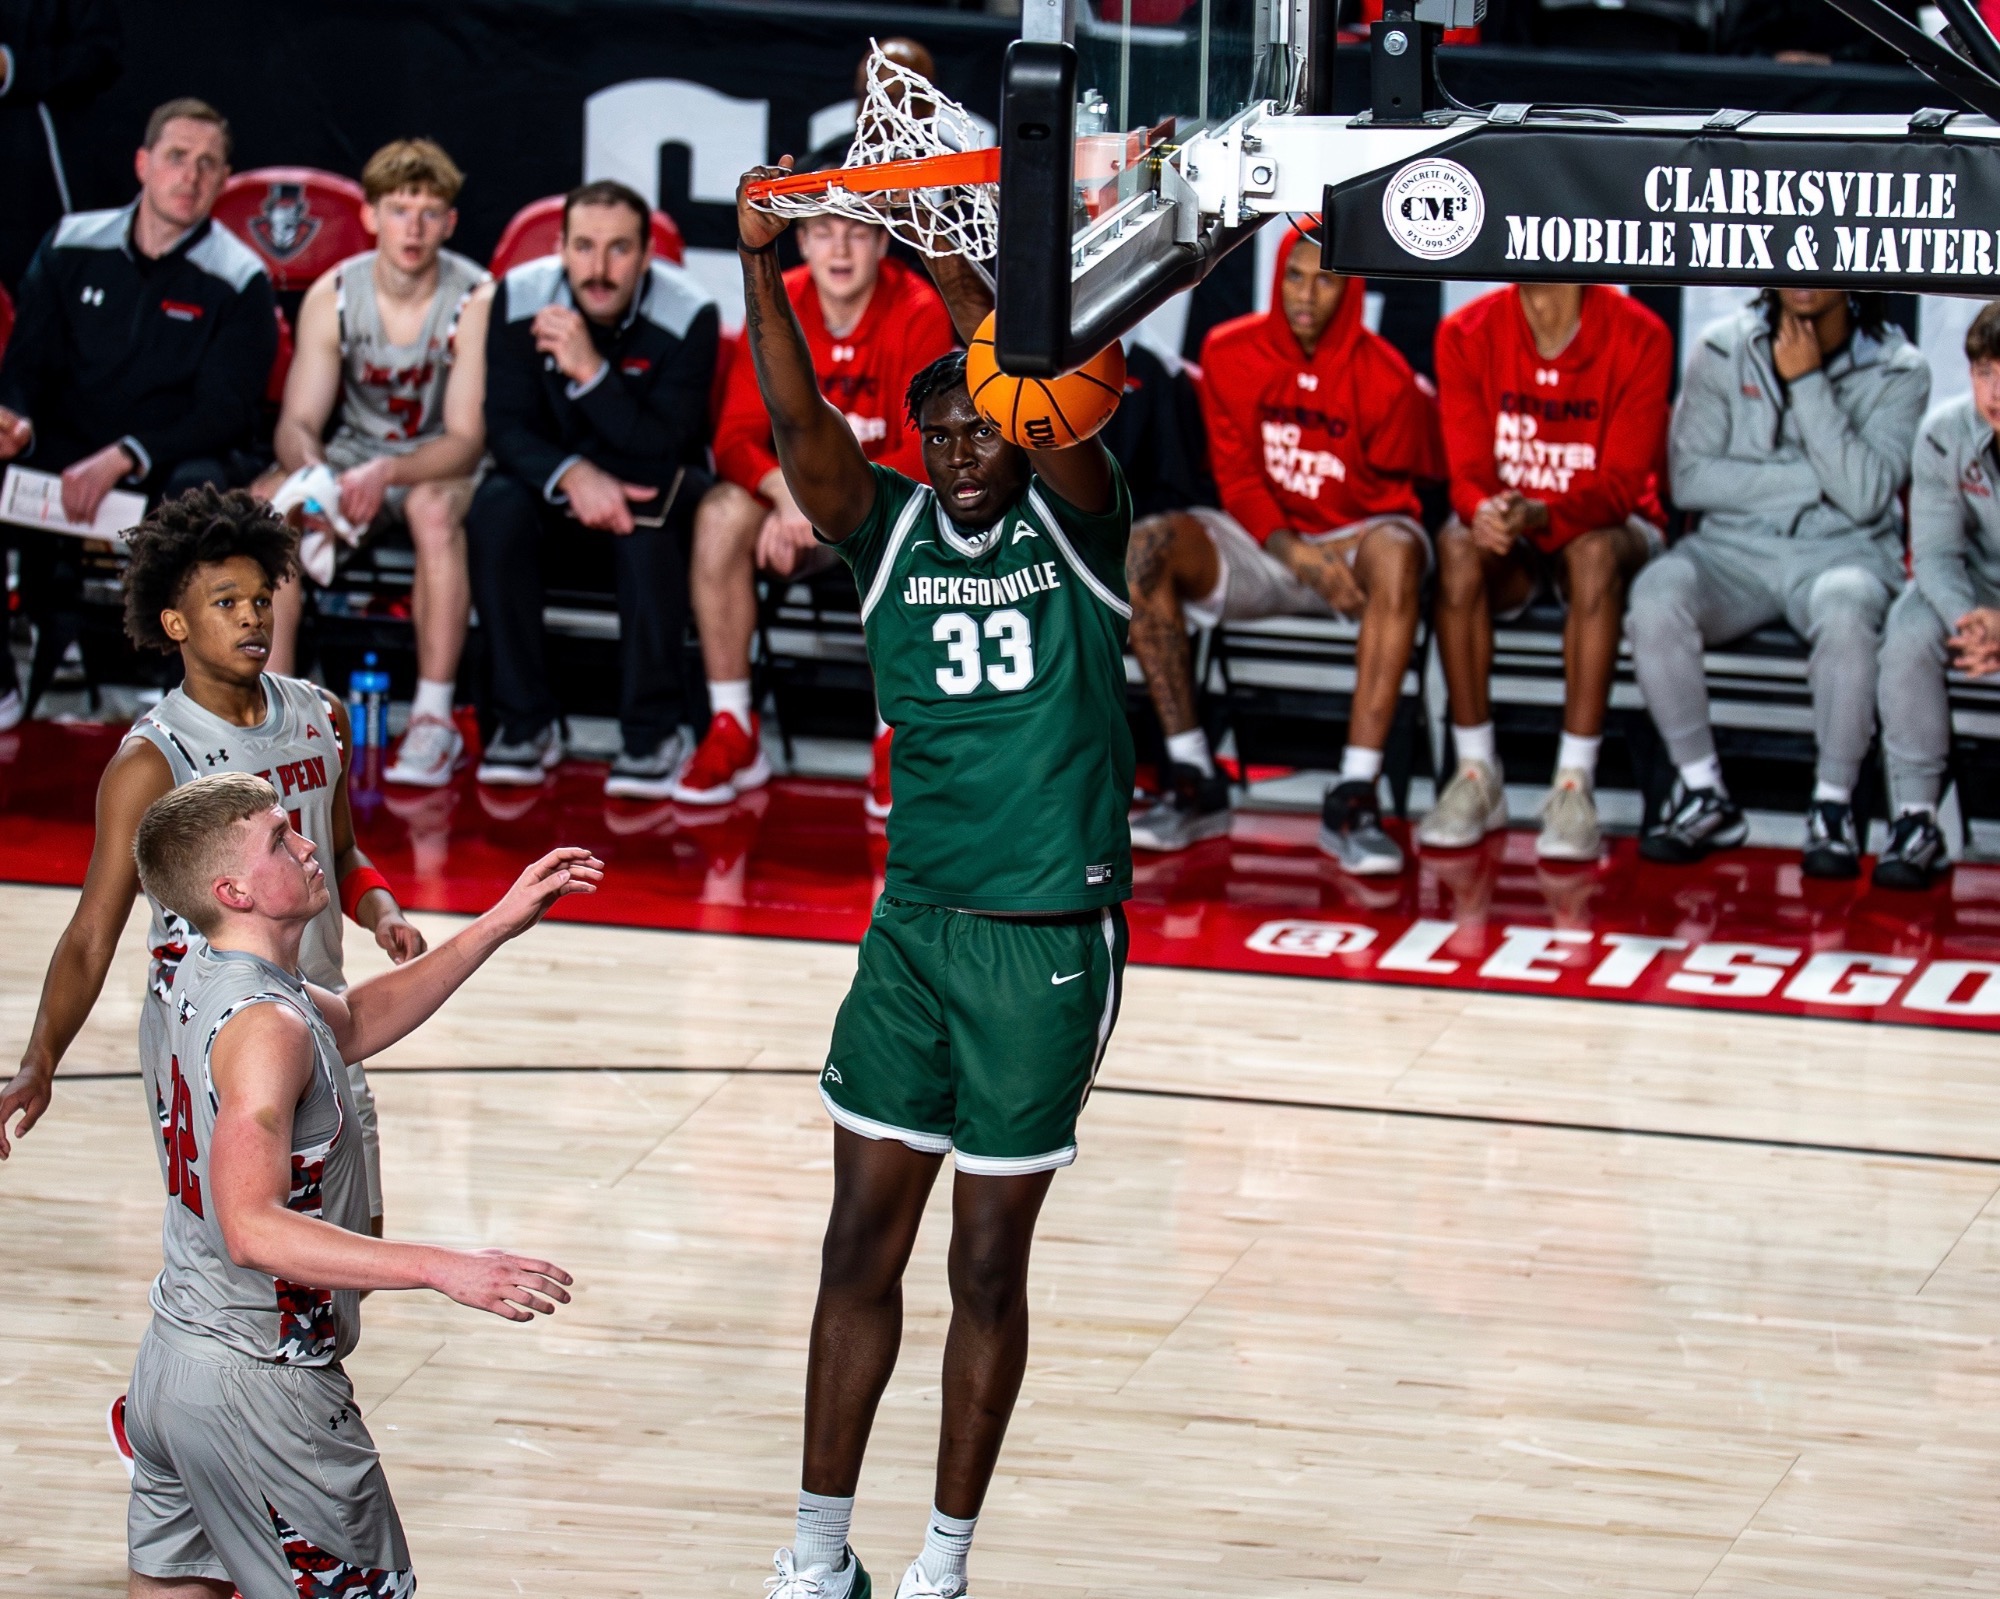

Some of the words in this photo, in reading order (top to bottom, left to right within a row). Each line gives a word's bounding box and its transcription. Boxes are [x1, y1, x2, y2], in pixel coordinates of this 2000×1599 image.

[1398, 170, 1441, 194] CONCRETE
[1443, 173, 1457, 183] ON
[1456, 181, 1472, 197] TAP
[1644, 166, 1957, 219] CLARKSVILLE
[1504, 215, 1676, 267] MOBILE
[1688, 222, 1775, 270] MIX
[1786, 224, 1820, 271] &
[1496, 411, 1538, 441] NO
[1494, 440, 1596, 471] MATTER
[1499, 464, 1575, 494] WHAT
[903, 561, 1061, 606] JACKSONVILLE
[932, 608, 1034, 695] 33
[276, 755, 328, 797] PEAY
